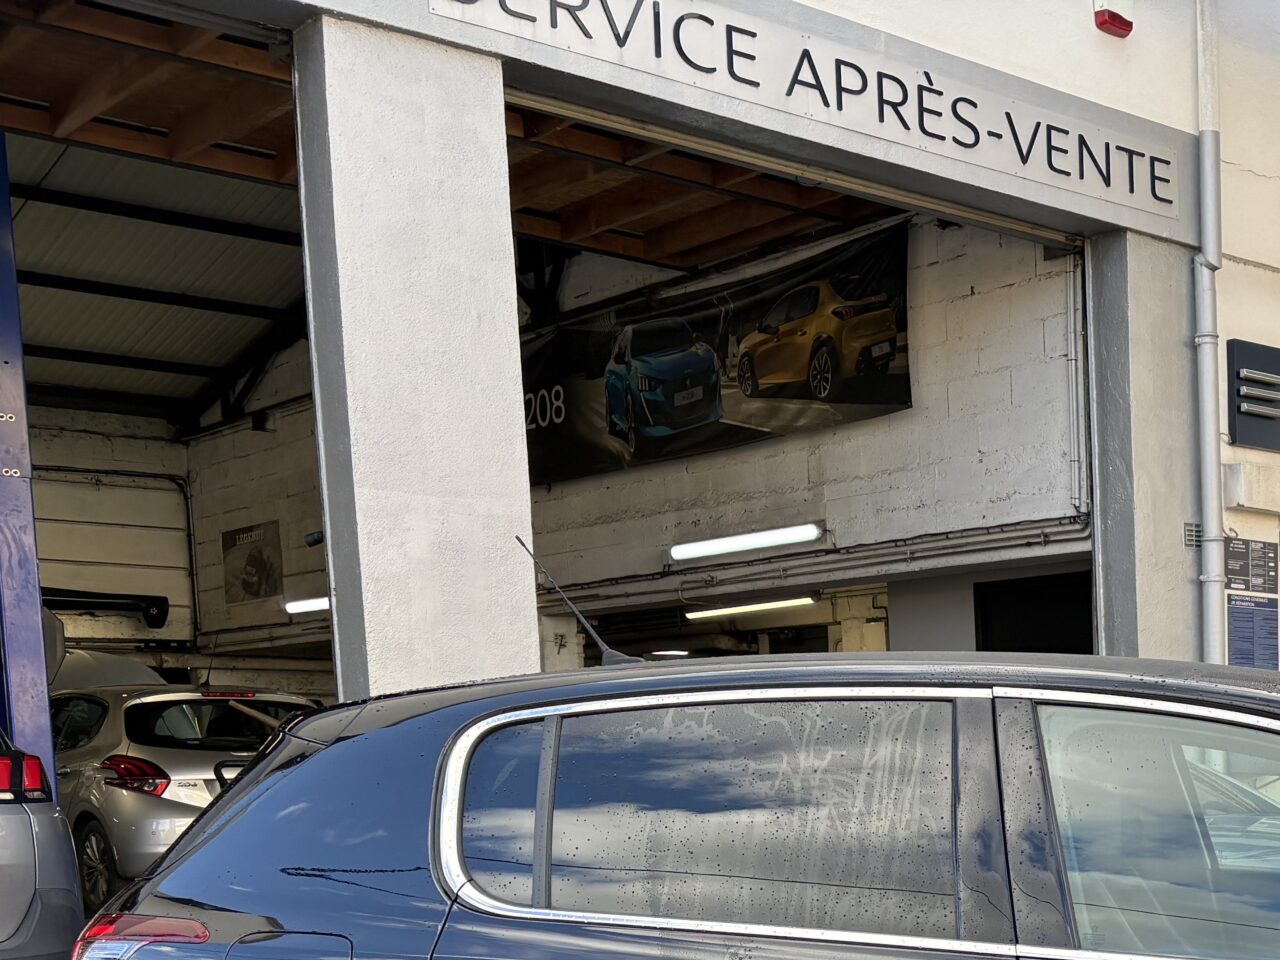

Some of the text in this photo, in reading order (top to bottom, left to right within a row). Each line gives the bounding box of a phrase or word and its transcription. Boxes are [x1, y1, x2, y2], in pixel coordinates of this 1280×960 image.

[456, 0, 1174, 204] RVICE APRÈS-VENTE
[525, 385, 566, 430] 208
